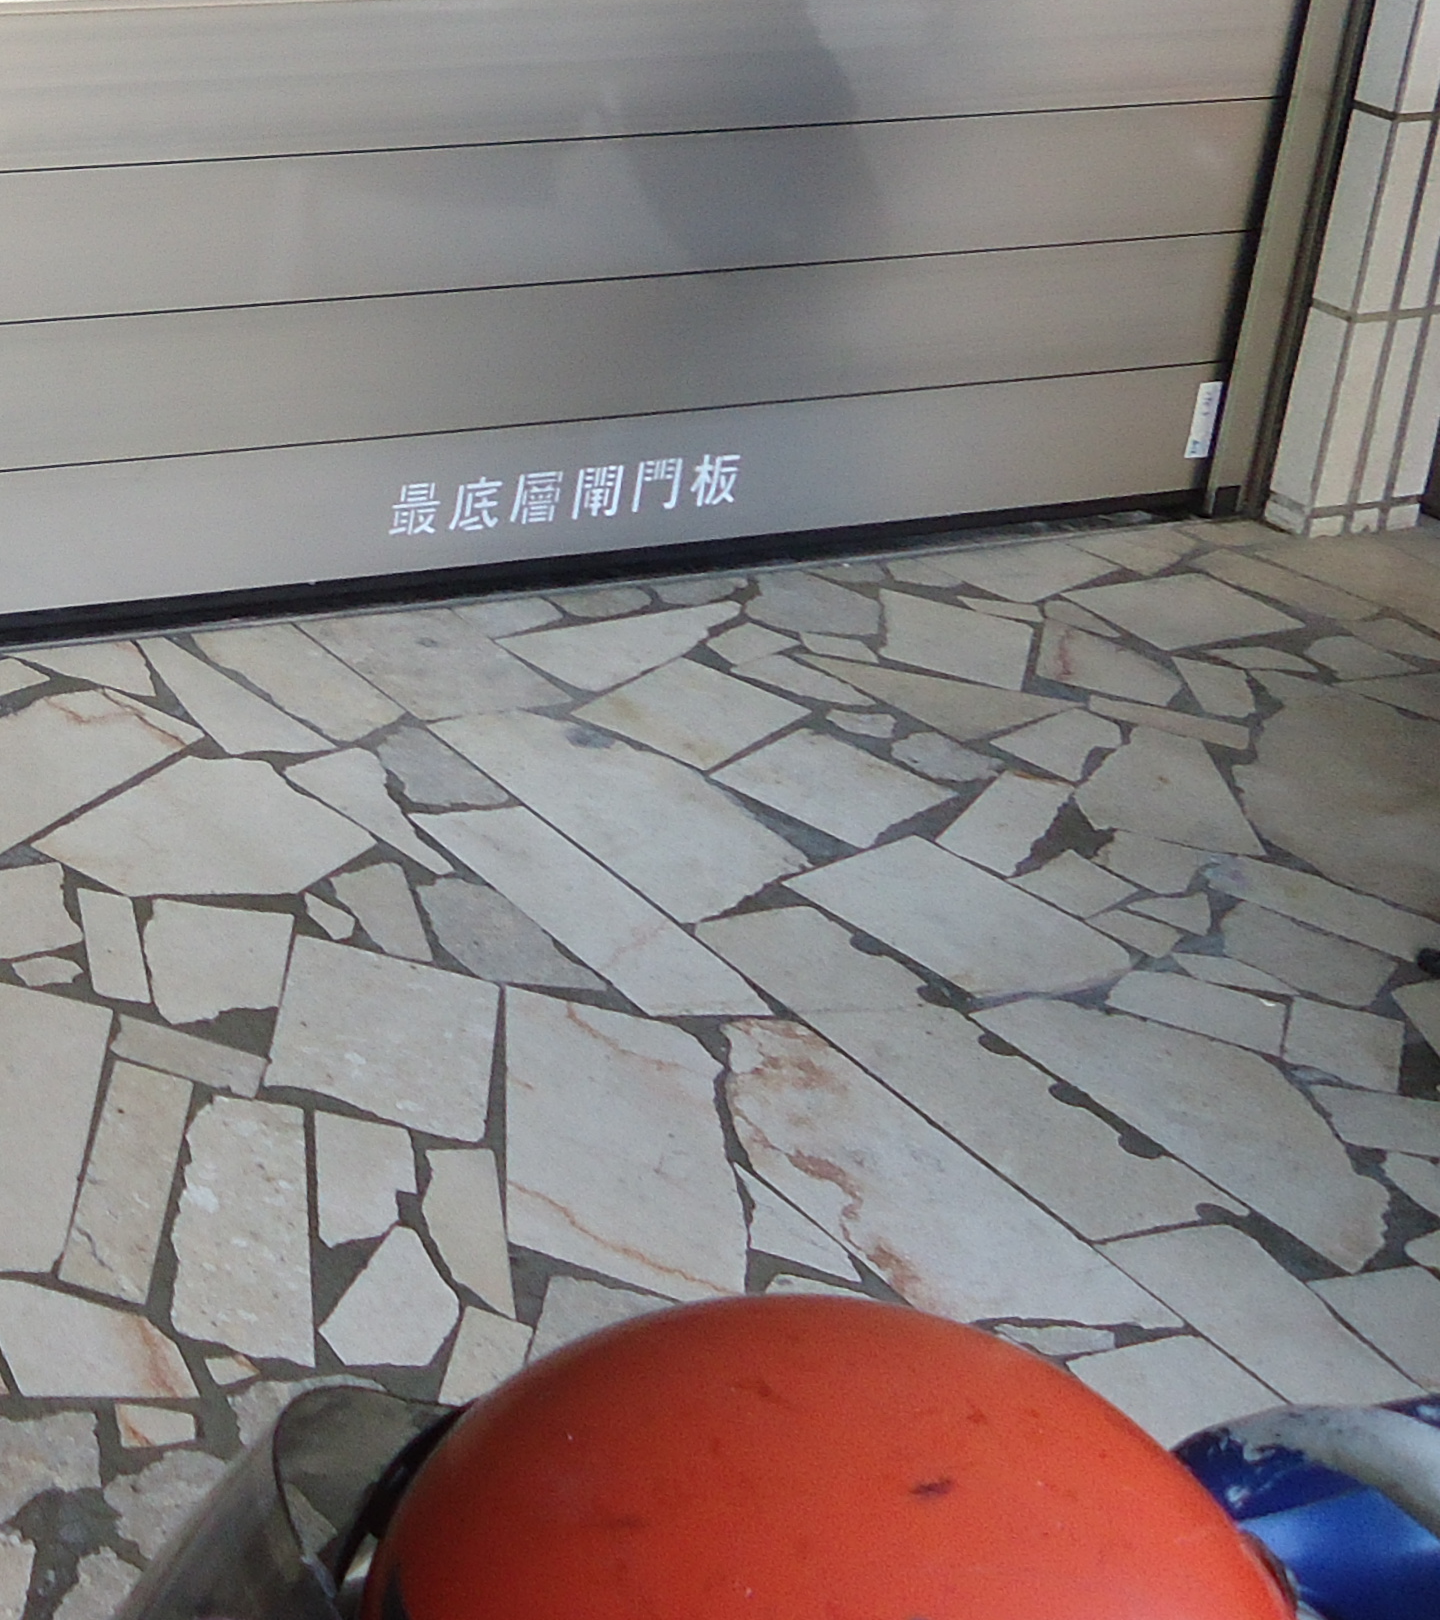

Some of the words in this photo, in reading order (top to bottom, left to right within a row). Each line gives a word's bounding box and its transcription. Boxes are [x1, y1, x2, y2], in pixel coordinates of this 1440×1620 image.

[388, 453, 742, 535] 最底層閘門板
